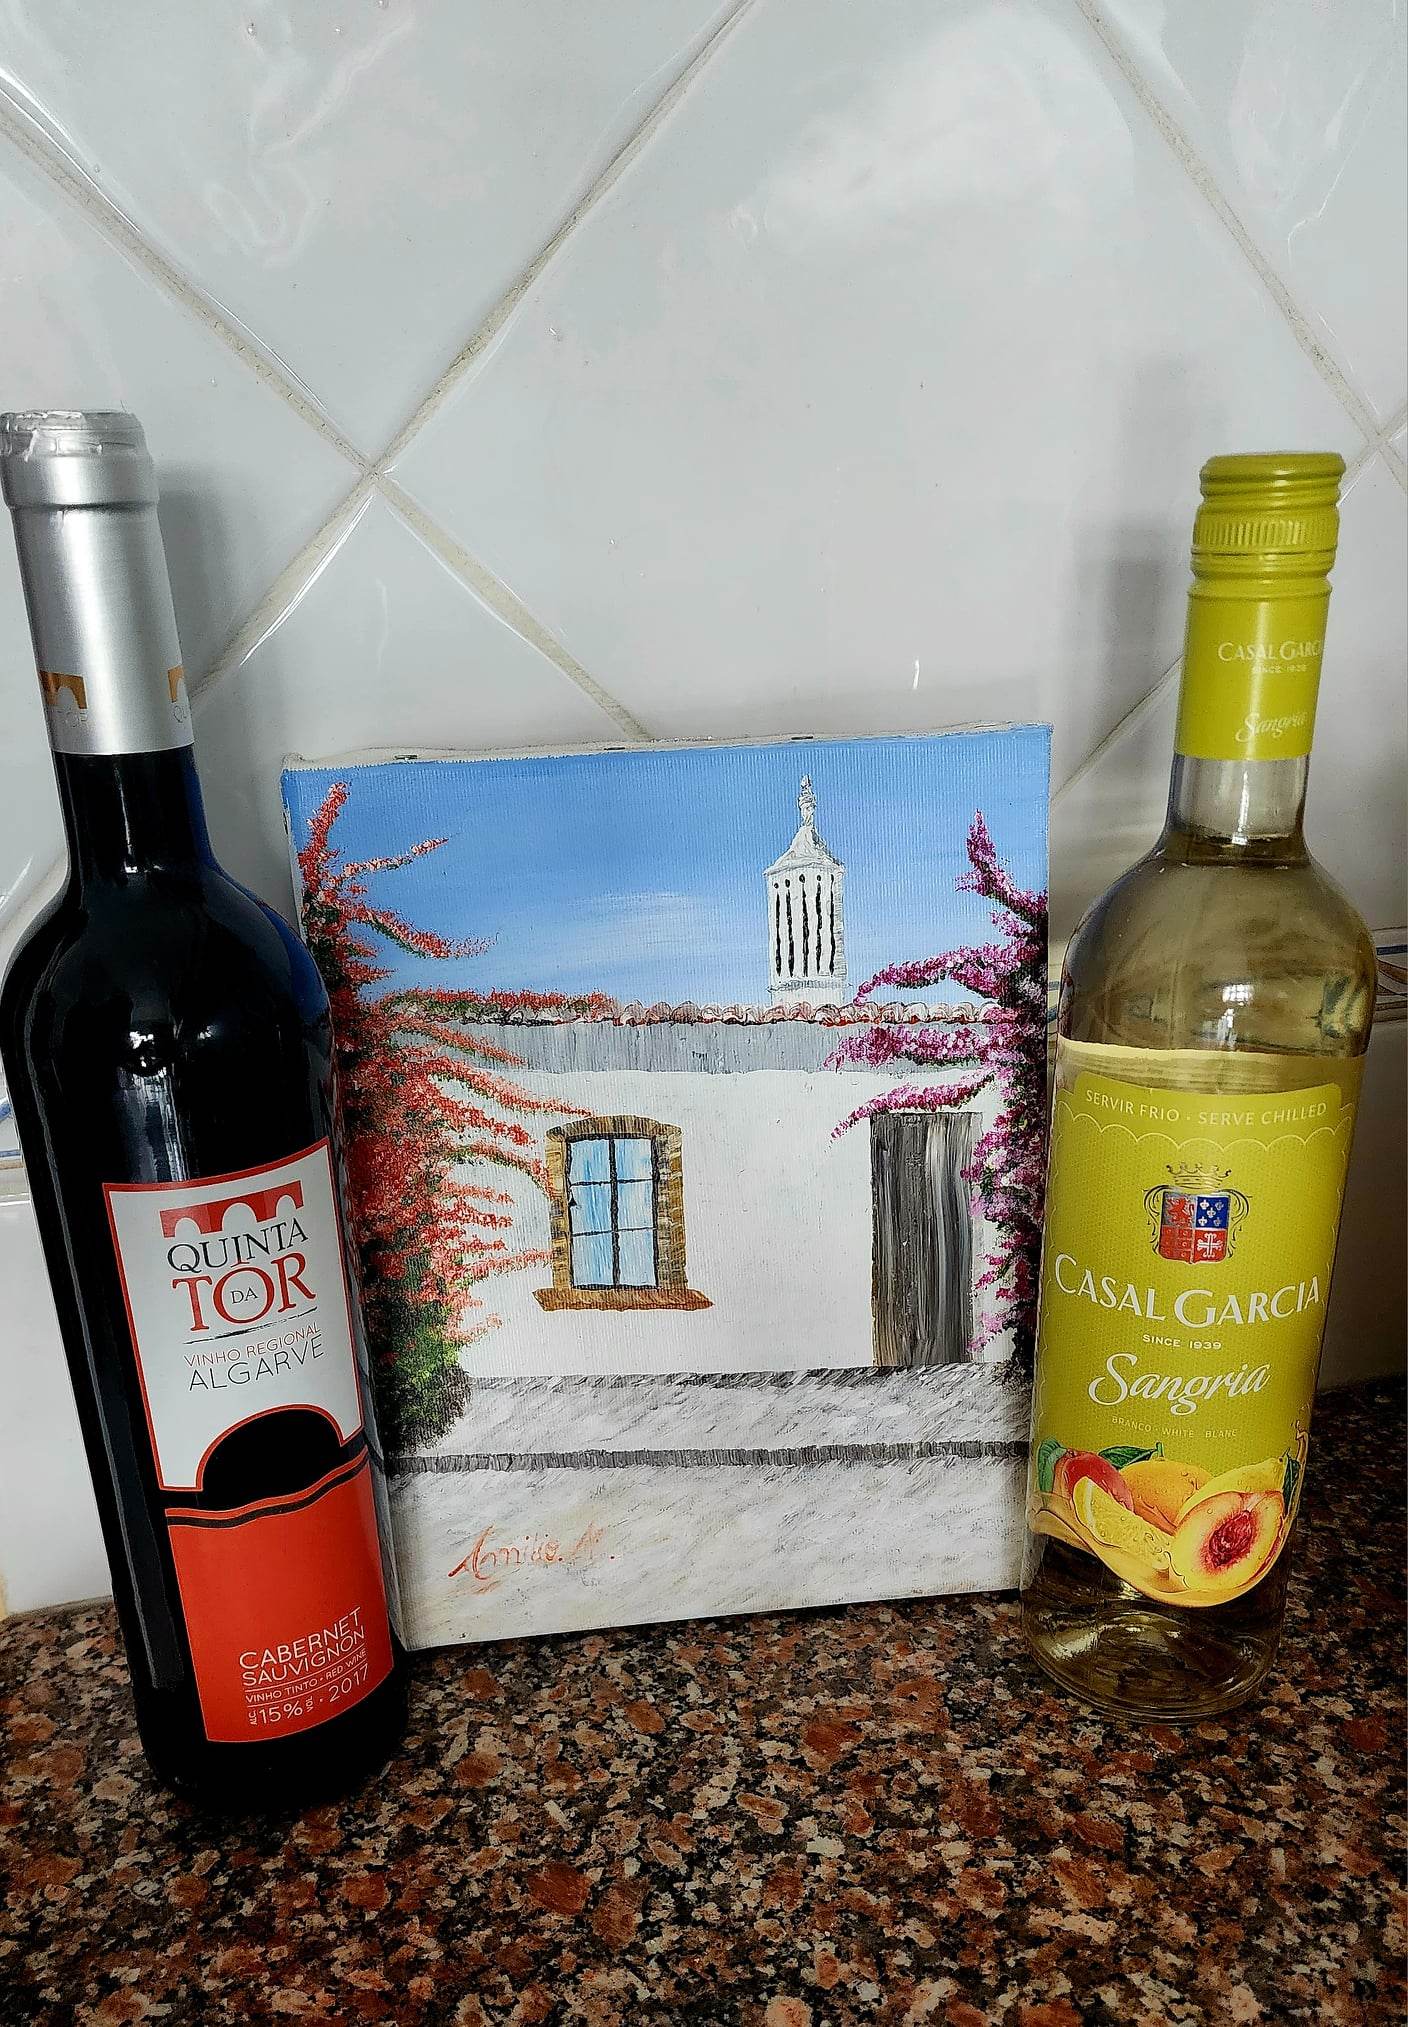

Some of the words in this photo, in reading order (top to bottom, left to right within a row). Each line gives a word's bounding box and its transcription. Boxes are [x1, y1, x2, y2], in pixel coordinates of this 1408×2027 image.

[1218, 642, 1278, 661] CASAL
[1086, 1089, 1134, 1115] SERVIR
[1139, 1104, 1180, 1123] FRIO
[1199, 1111, 1254, 1126] SERVE
[1261, 1102, 1327, 1126] CHILLED
[167, 1217, 309, 1273] QUINTA
[172, 1251, 317, 1332] TOR
[230, 1287, 259, 1305] DA
[1055, 1253, 1167, 1322] CASAL
[1174, 1275, 1320, 1329] GARCIA
[184, 1348, 241, 1367] VINHO
[246, 1322, 321, 1358] REGIONAL
[189, 1333, 324, 1391] ALGARVE
[1142, 1333, 1181, 1348] SINCE
[1189, 1340, 1222, 1350] 1939
[1087, 1353, 1272, 1416] Sangria
[1112, 1415, 1152, 1432] BRANCO
[1162, 1427, 1194, 1438] WHITE
[239, 1606, 361, 1670] CABERNET
[242, 1624, 365, 1687] SAUVIGNON
[245, 1690, 281, 1703] VINHO
[284, 1678, 318, 1696] TINTO
[325, 1665, 344, 1680] RED
[345, 1647, 367, 1668] WINE
[259, 1700, 303, 1724] 15%
[328, 1662, 368, 1703] 2017
